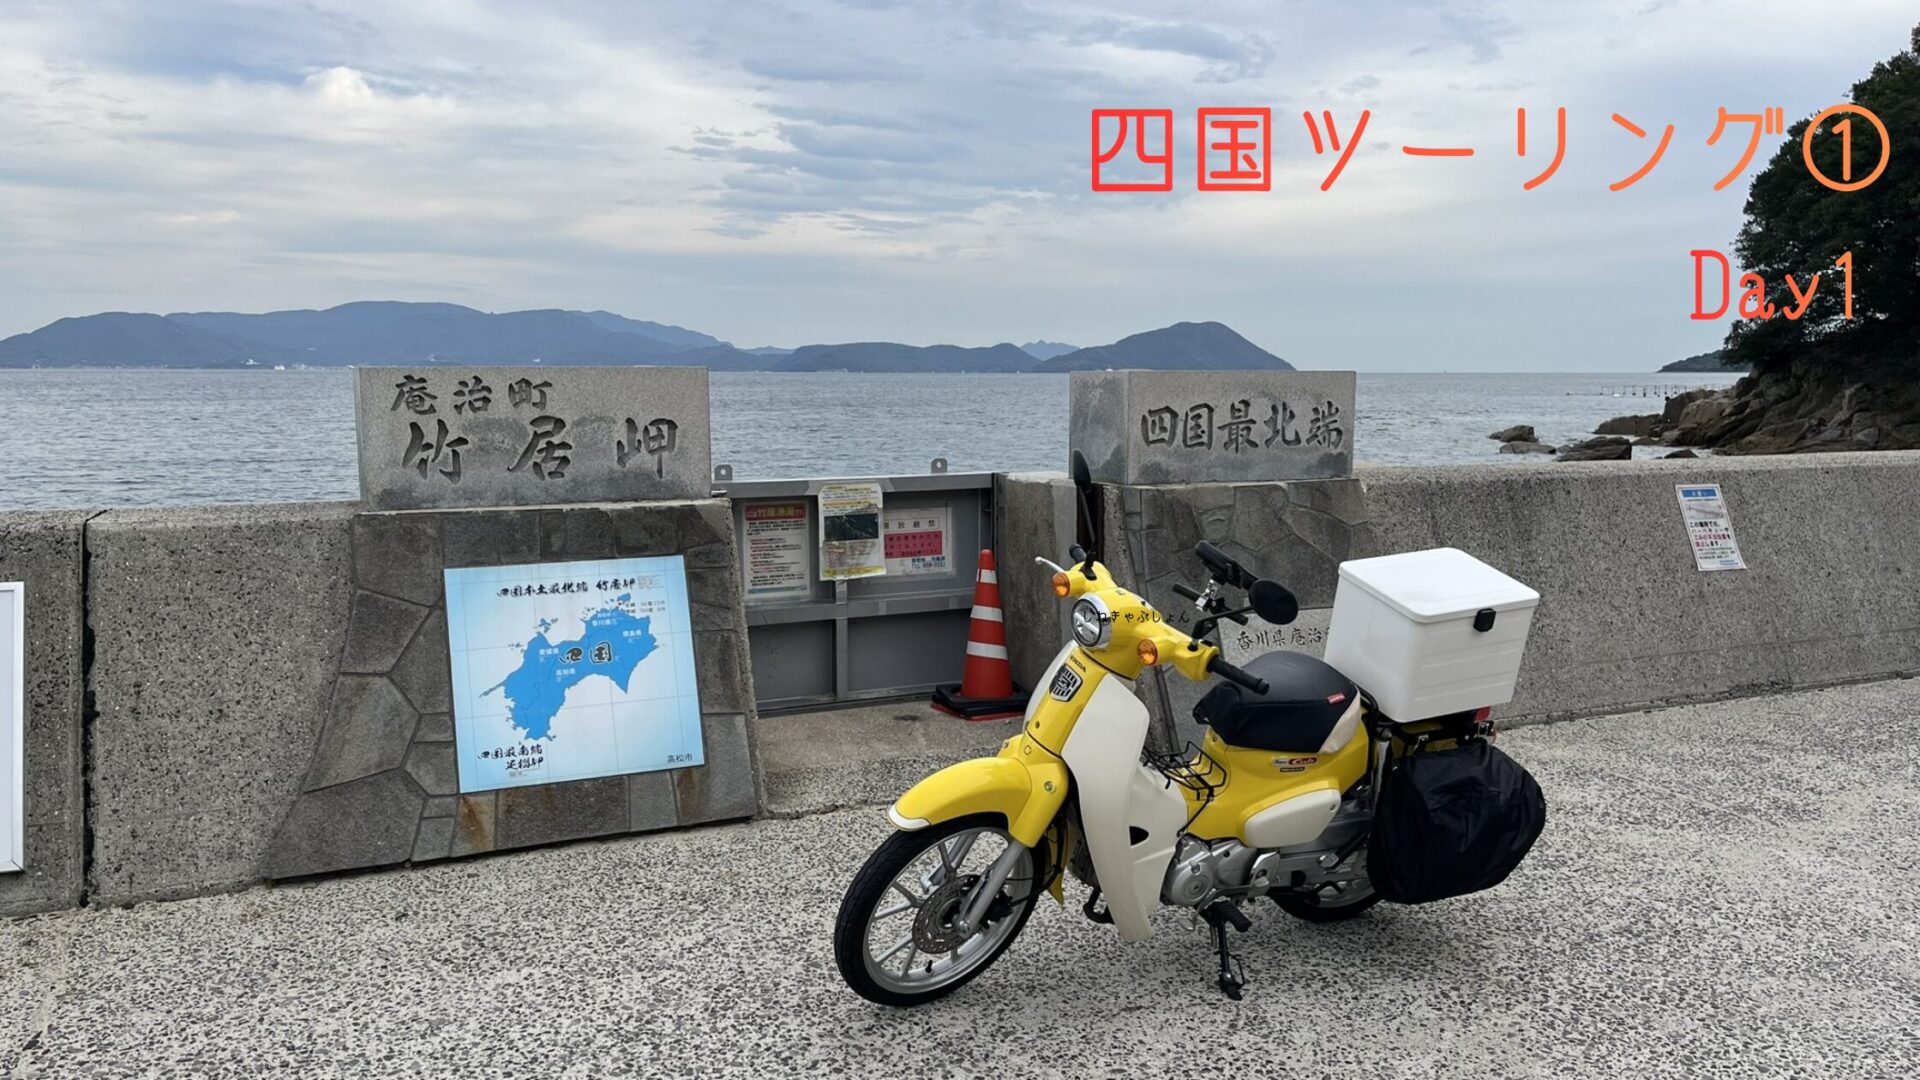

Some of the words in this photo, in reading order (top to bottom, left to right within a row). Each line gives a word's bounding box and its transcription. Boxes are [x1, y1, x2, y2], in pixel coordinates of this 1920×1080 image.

[391, 374, 553, 415] 庵治町
[402, 415, 679, 484] 竹居岬
[1140, 399, 1344, 453] 四国最北端
